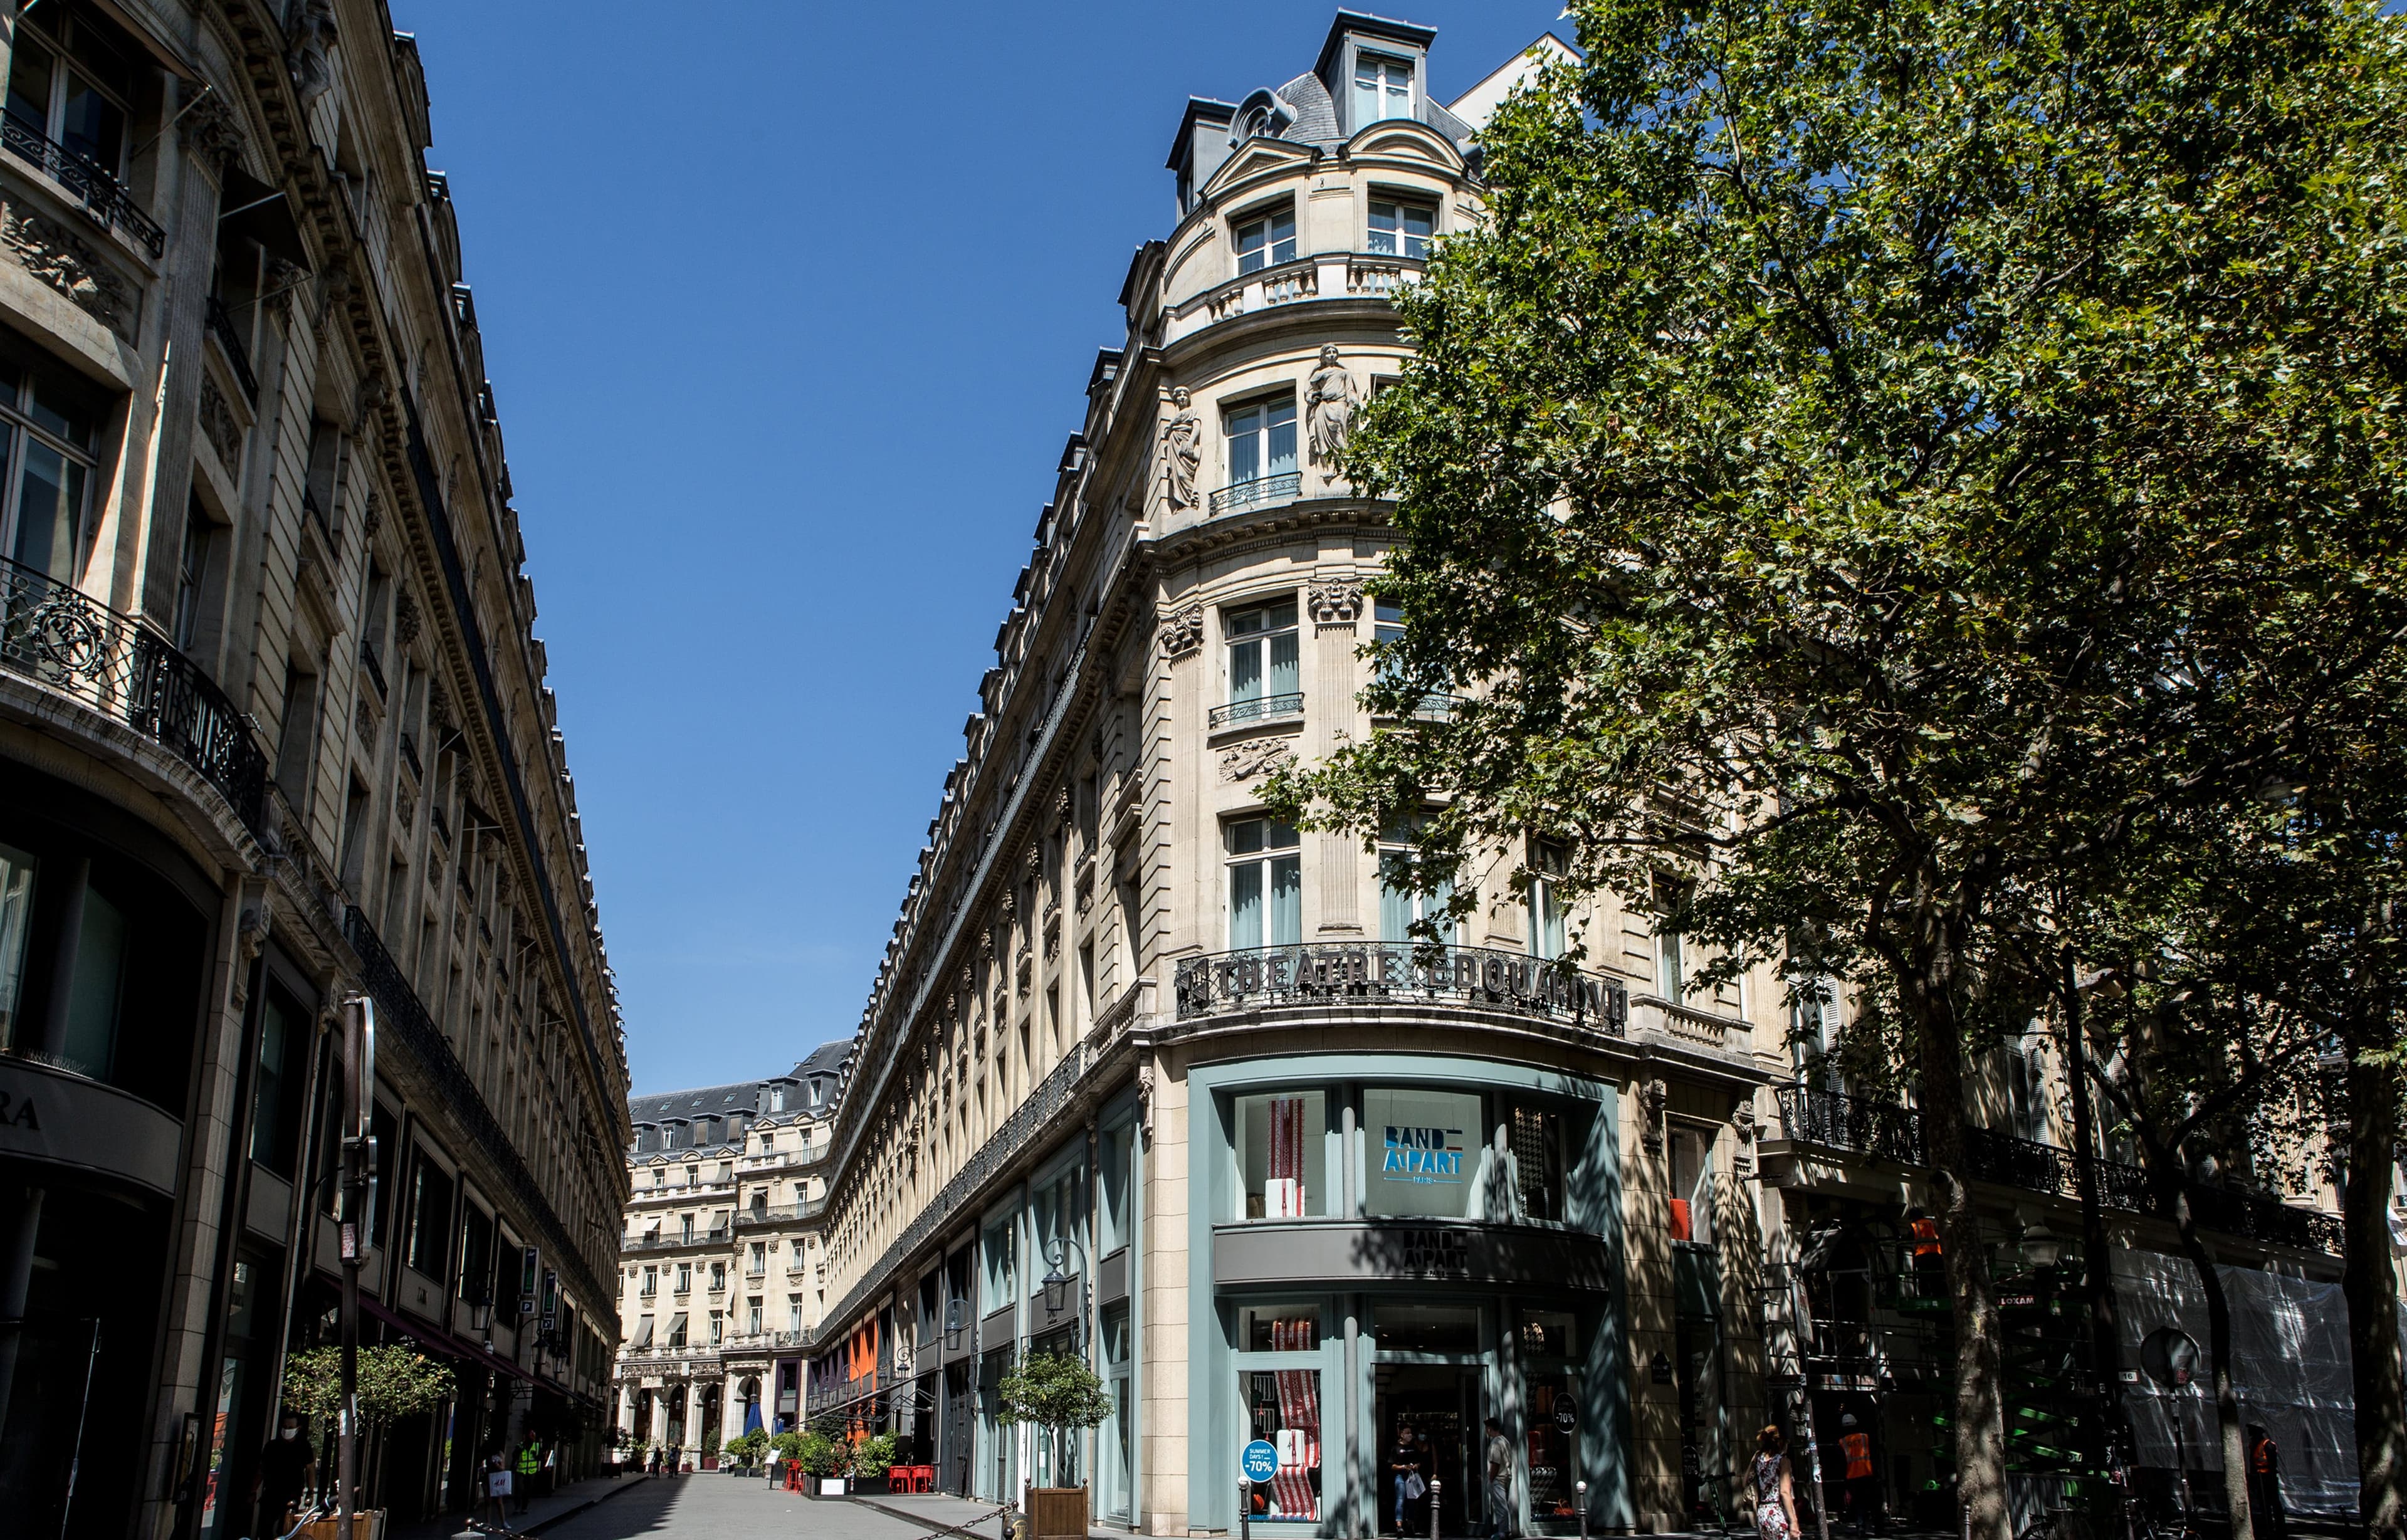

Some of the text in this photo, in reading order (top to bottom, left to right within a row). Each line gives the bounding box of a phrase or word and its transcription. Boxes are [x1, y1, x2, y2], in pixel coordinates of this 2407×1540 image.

[1214, 950, 1398, 997] THEATRE
[1413, 1176, 1434, 1184] PARIS
[2000, 1297, 2035, 1305] LOXAM
[524, 1303, 530, 1311] P
[1556, 1412, 1575, 1423] -70%
[1245, 1460, 1272, 1472] -70%
